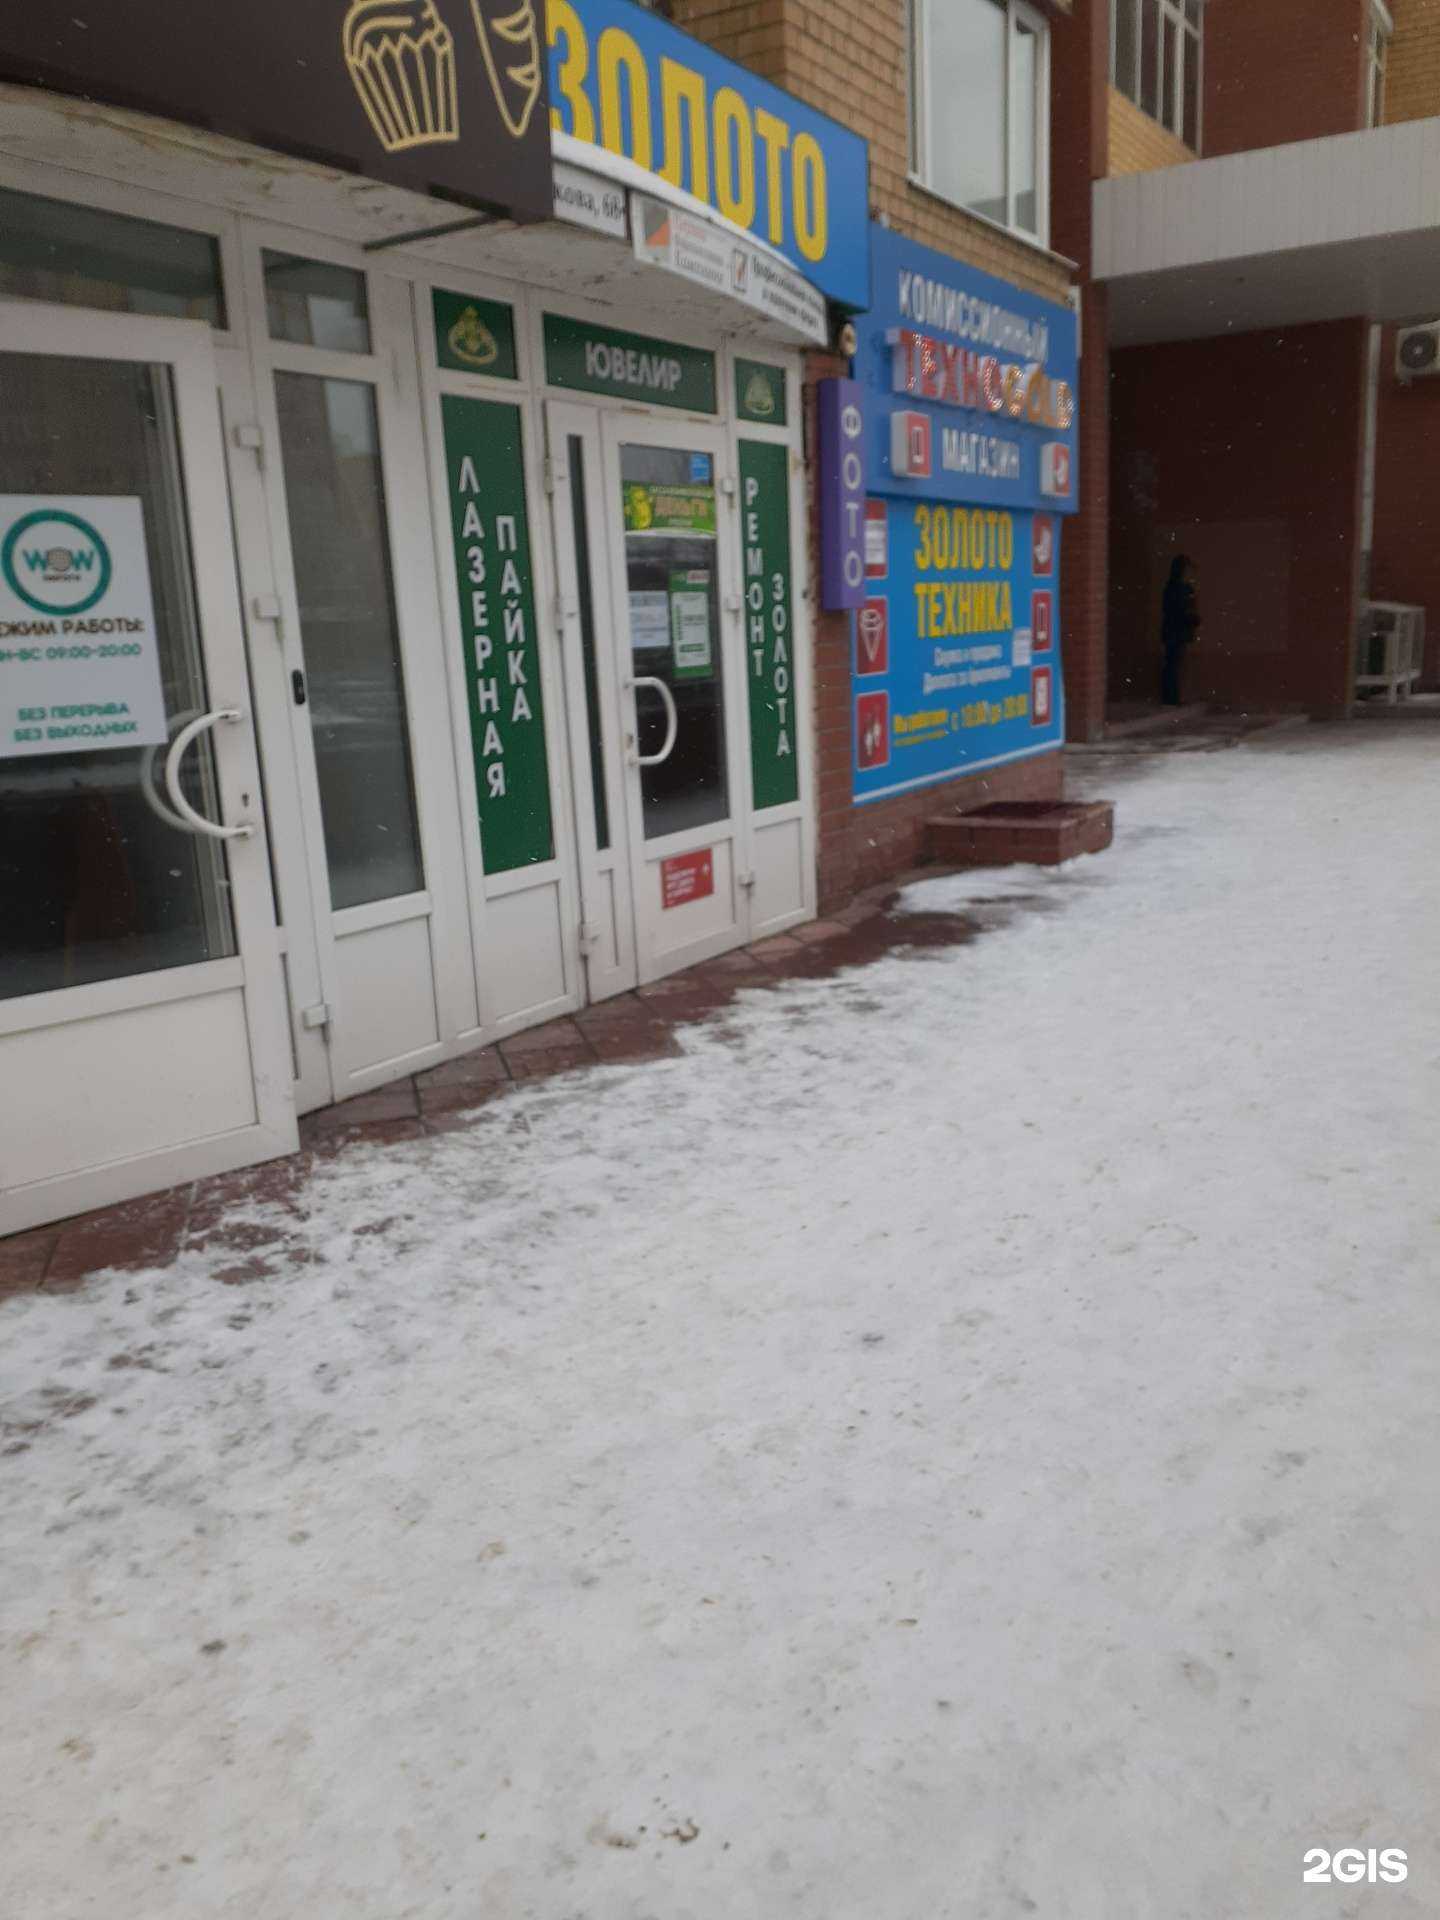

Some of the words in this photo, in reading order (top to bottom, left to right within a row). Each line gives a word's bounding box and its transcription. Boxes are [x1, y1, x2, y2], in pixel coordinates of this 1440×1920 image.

[545, 0, 827, 262] ЗОЛОТО
[585, 341, 682, 392] ЮВЕЛИР
[942, 427, 1020, 480] МАГАЗИН
[841, 405, 862, 587] ФОТО
[22, 547, 94, 572] WOW
[914, 504, 1014, 571] ЗОЛОТО
[745, 477, 765, 676] РЕМОНТ
[914, 581, 1013, 639] ТЕХНИКА
[459, 455, 506, 798] ЛАЗЕРНАЯ
[496, 515, 532, 722] ПАЙКА
[771, 572, 791, 756] ЗОЛОТА
[14, 727, 42, 742] БЕЗ
[47, 721, 137, 739] ВЫХОДНЫХ
[18, 706, 46, 722] БЕЗ
[51, 702, 129, 719] ПЕРЕРЫВА
